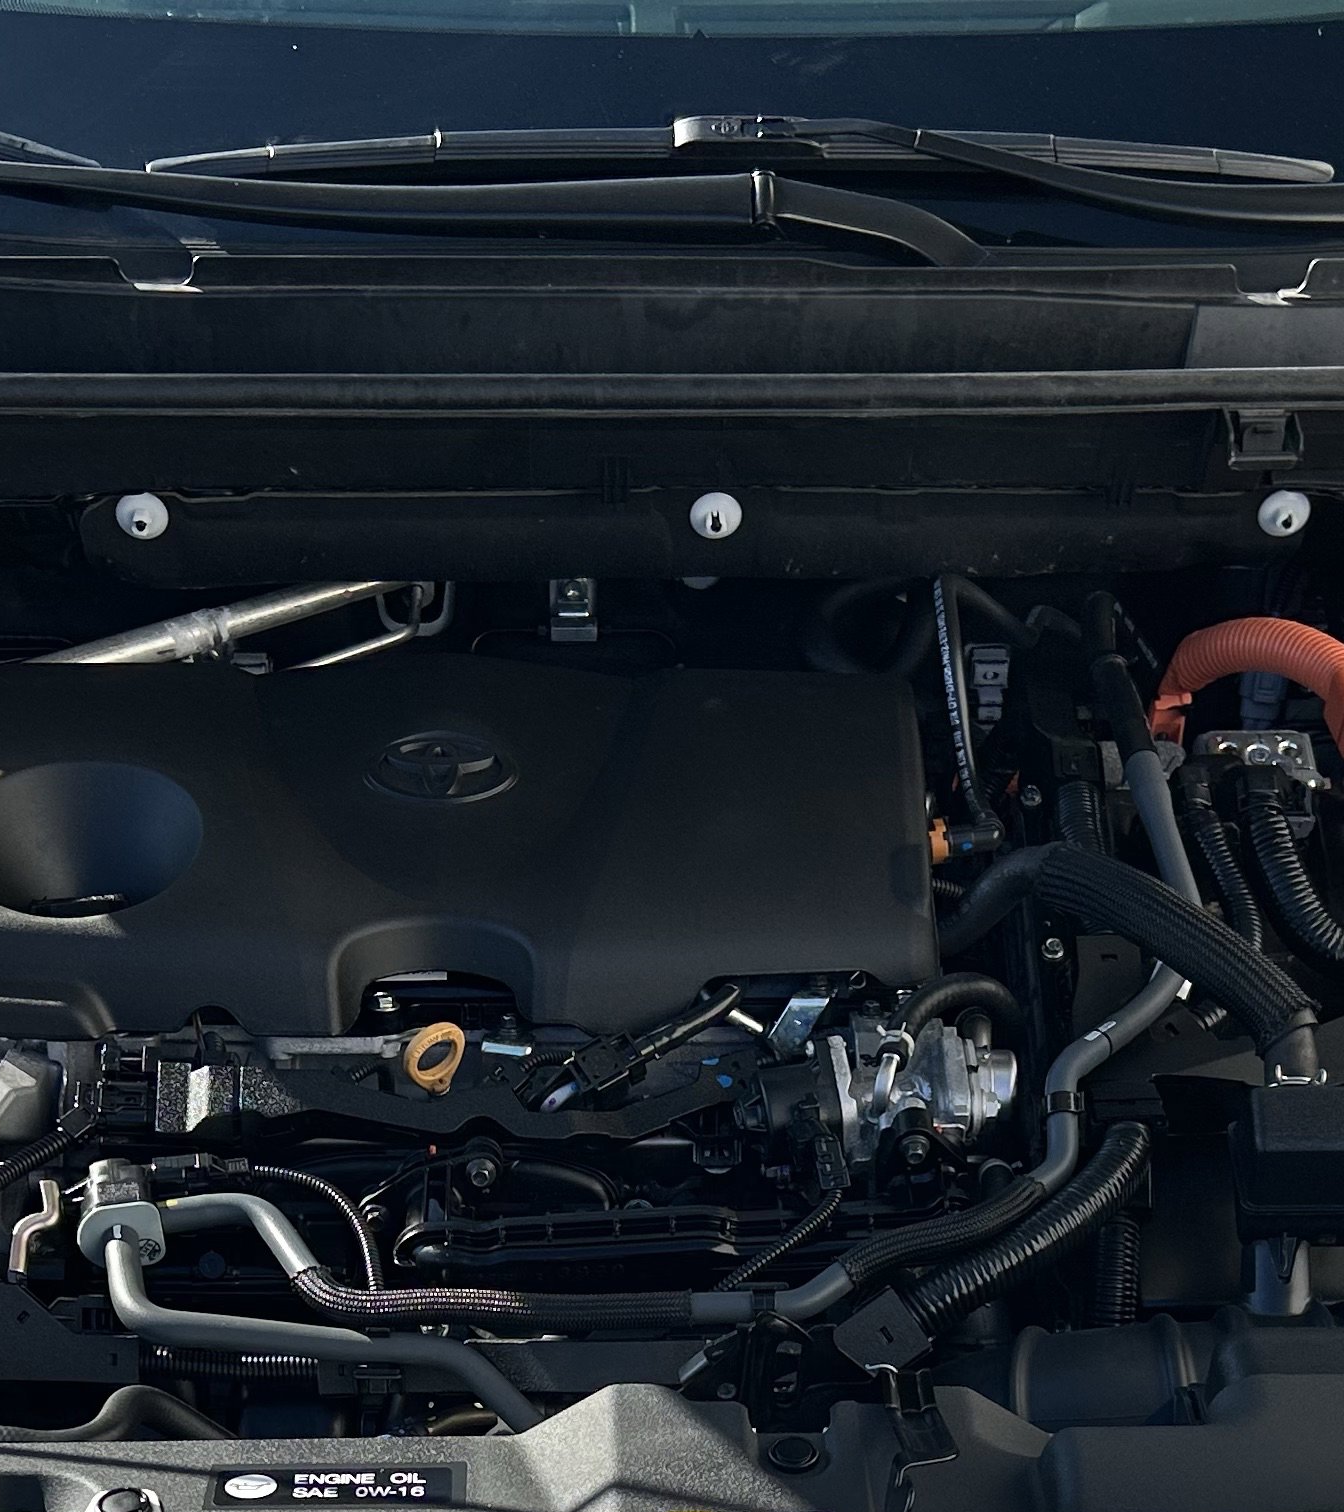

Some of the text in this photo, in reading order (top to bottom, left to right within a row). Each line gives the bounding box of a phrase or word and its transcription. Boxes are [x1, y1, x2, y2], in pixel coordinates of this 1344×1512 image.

[294, 1473, 427, 1485] ENGINE OIL
[292, 1486, 425, 1498] SAE 0W-16
